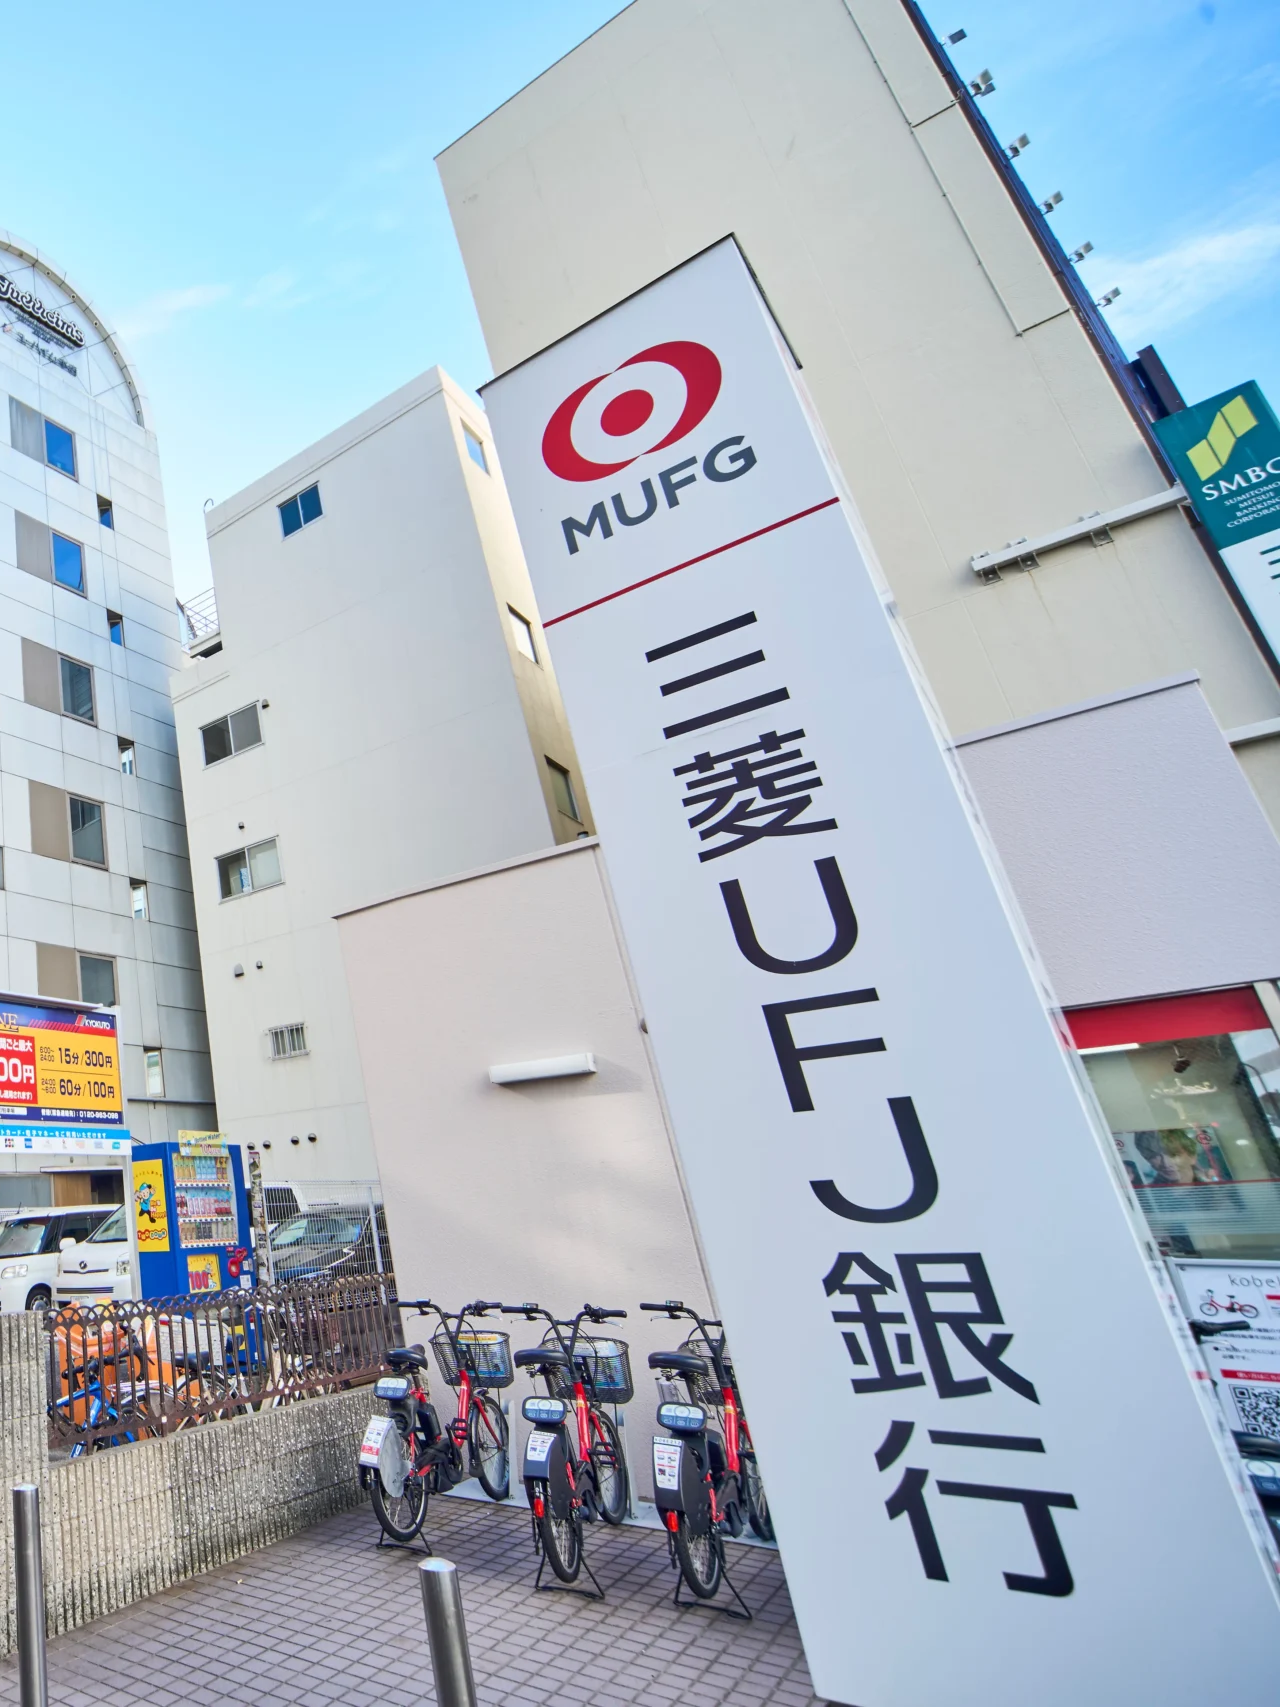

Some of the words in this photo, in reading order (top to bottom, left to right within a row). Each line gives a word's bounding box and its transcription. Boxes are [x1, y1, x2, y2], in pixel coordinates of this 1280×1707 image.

[560, 435, 758, 555] MUFG
[1238, 491, 1275, 508] MITSUI
[644, 610, 1078, 1597] 三菱UFJ銀行
